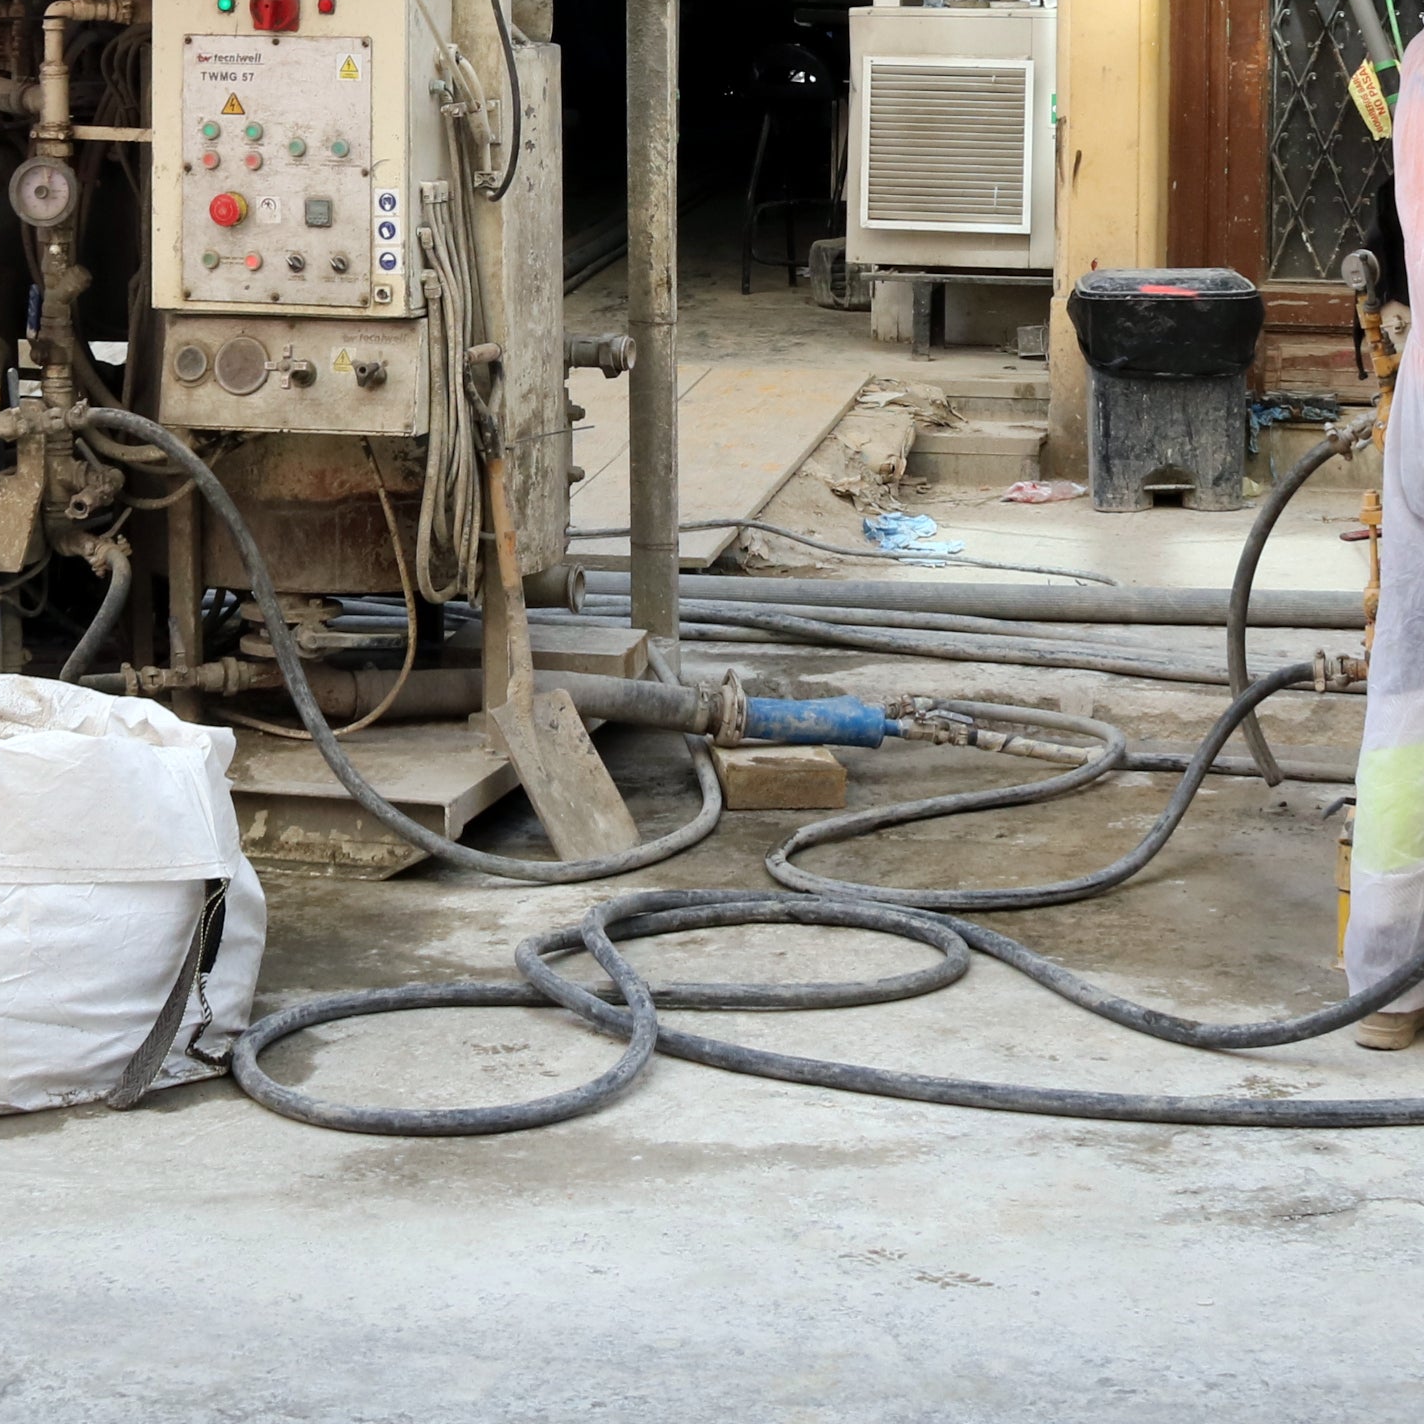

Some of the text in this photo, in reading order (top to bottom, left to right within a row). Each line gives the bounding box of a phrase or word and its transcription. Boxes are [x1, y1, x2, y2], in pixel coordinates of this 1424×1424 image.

[213, 53, 262, 63] tecniwell
[201, 71, 254, 82] TWMG 57
[1358, 65, 1386, 116] NO PASA
